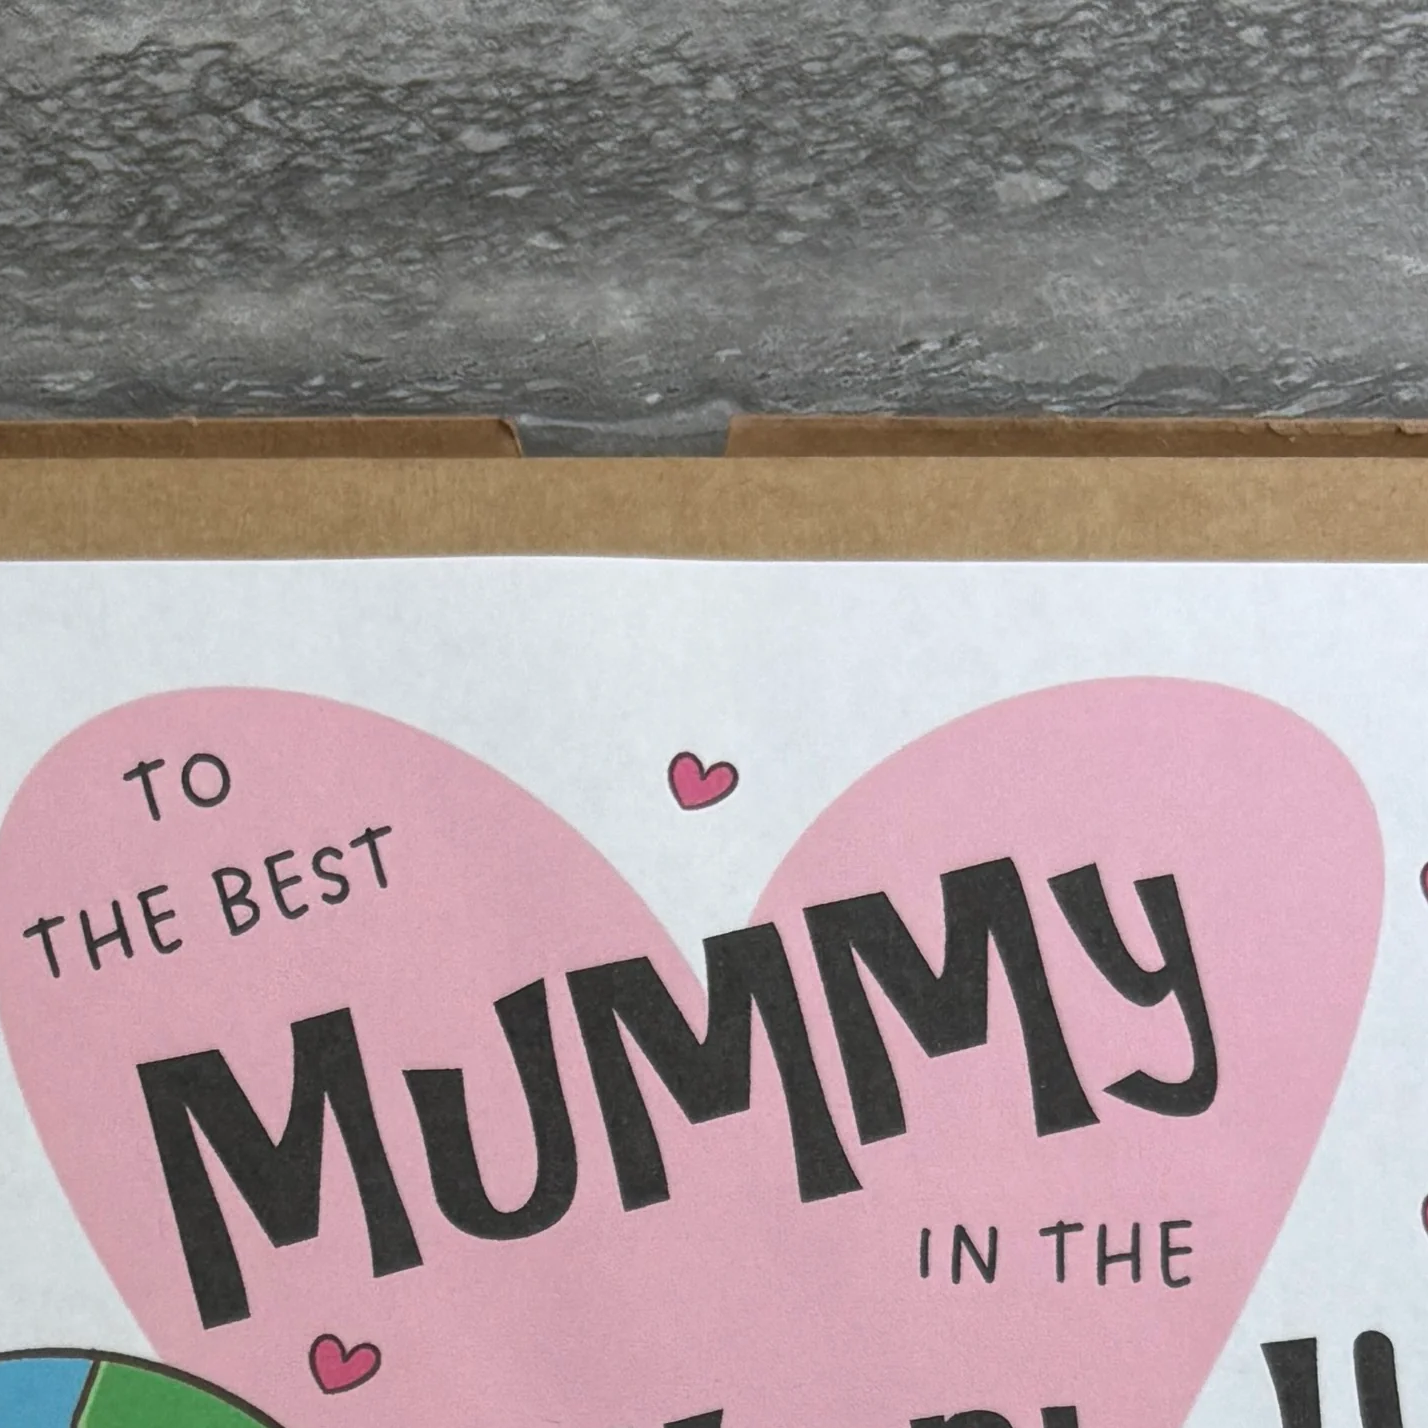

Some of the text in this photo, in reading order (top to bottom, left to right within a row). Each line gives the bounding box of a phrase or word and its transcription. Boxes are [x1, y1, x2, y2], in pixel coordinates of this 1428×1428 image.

[124, 754, 232, 821] TO
[24, 826, 393, 977] THE BEST
[920, 1219, 1193, 1287] IN THE
